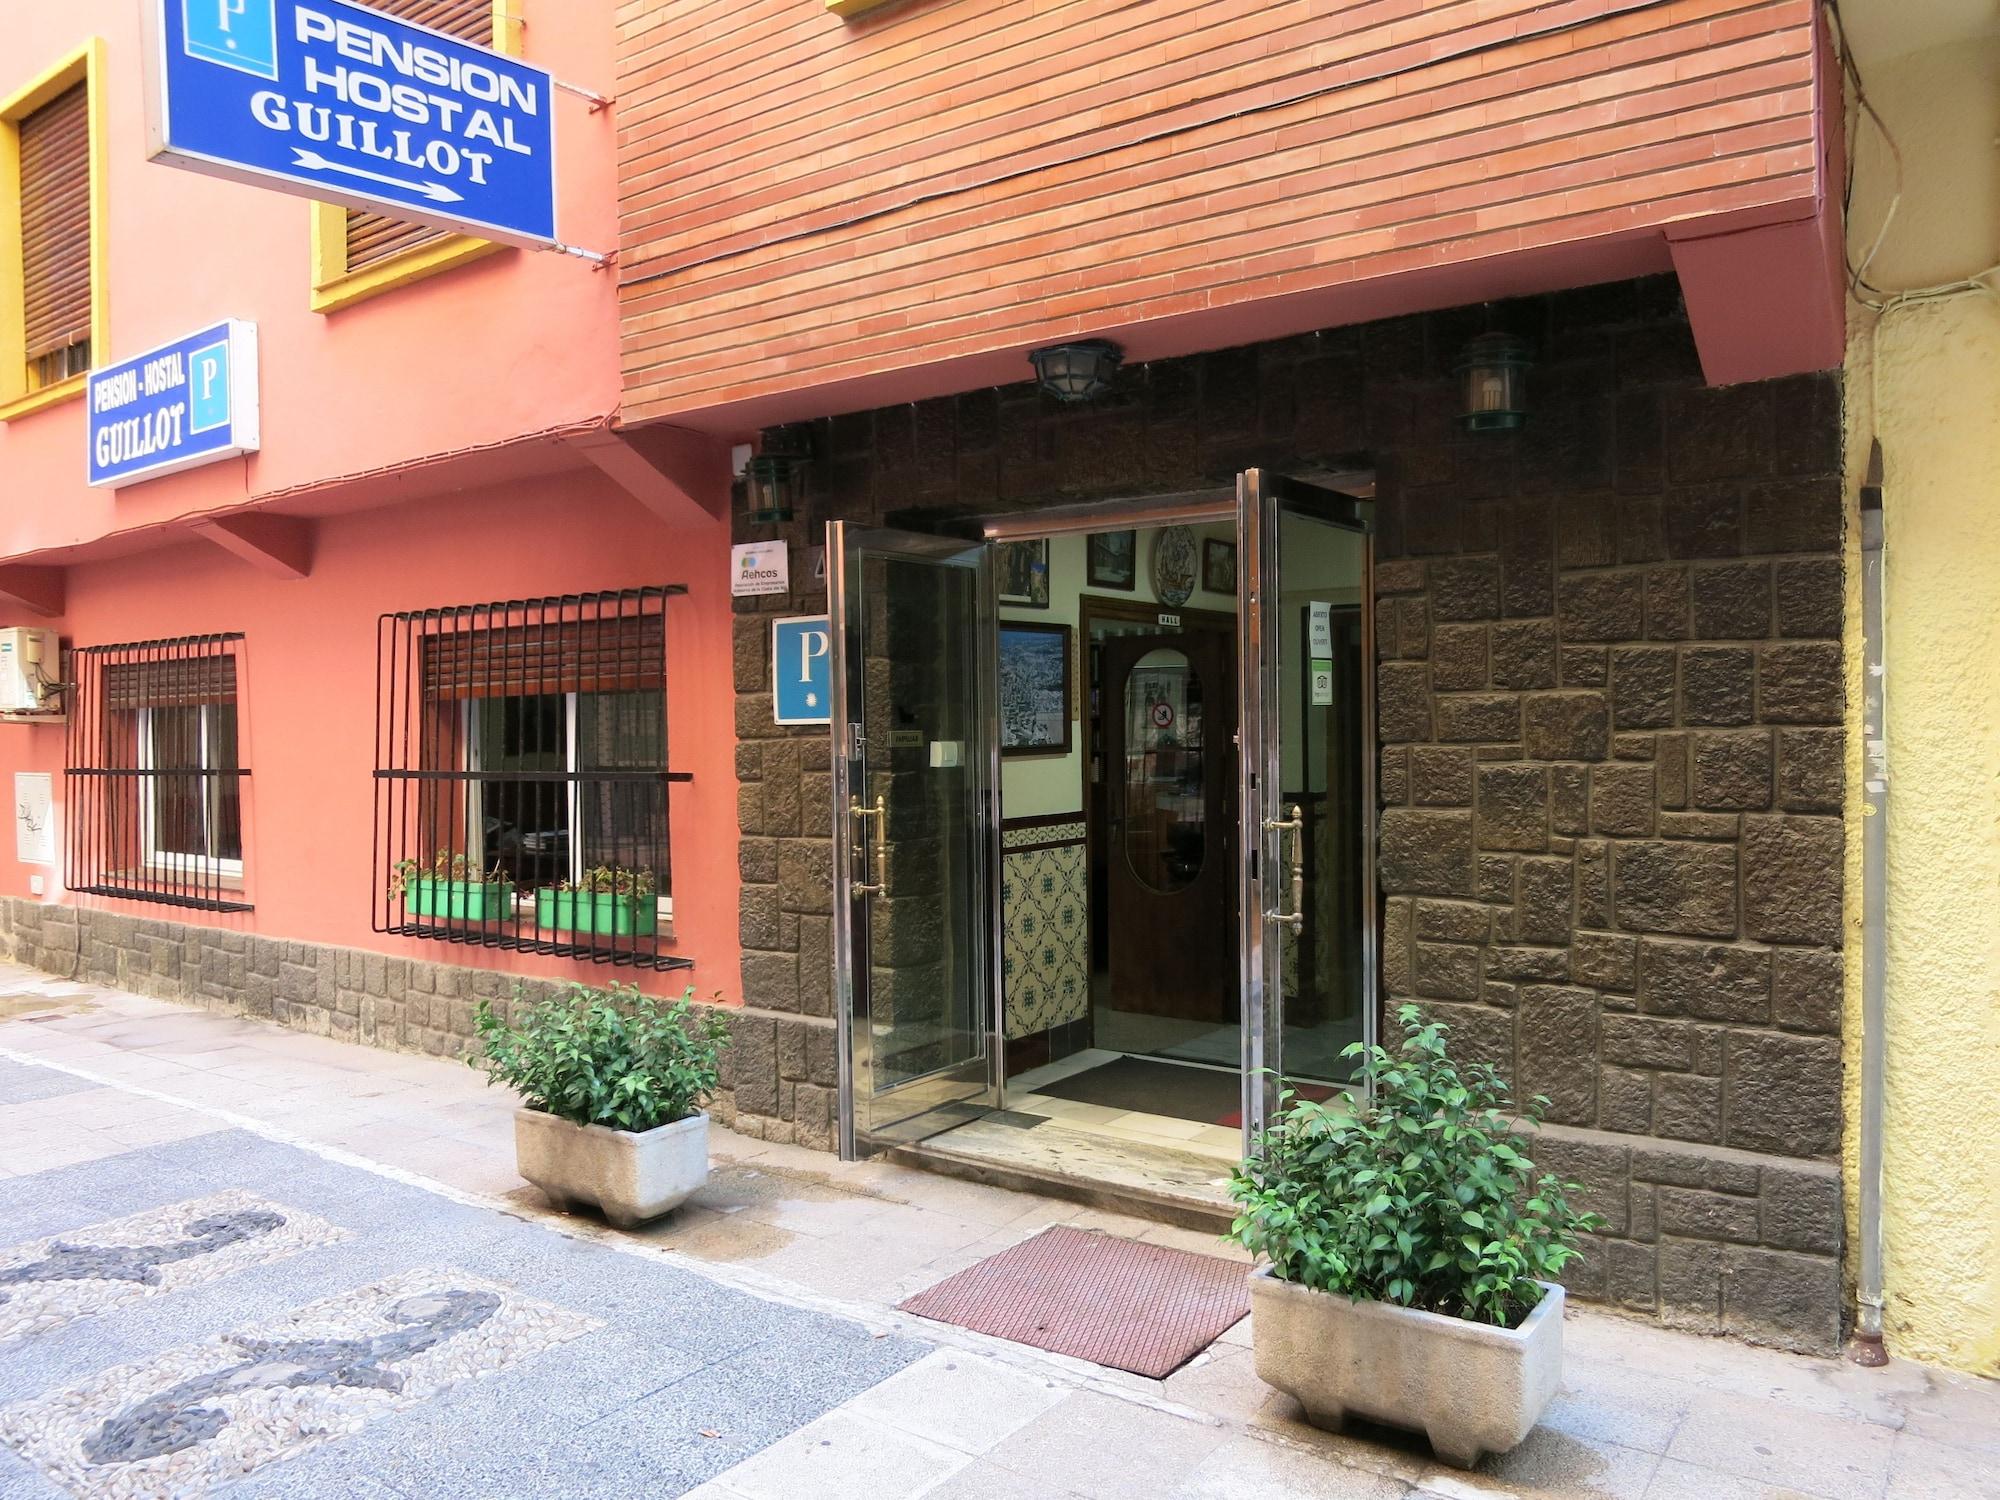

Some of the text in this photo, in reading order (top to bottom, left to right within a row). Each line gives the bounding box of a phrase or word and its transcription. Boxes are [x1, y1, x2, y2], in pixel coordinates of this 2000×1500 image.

[295, 5, 537, 116] PENSION
[304, 55, 532, 156] HOSTAL
[250, 91, 492, 185] GUILLOT
[94, 369, 138, 414] PENSION
[144, 352, 185, 397] HOSTAL
[201, 358, 217, 400] P
[96, 401, 185, 468] GUILLOT
[741, 569, 778, 580] Aehcos
[1161, 615, 1178, 625] HALL
[798, 631, 829, 683] P
